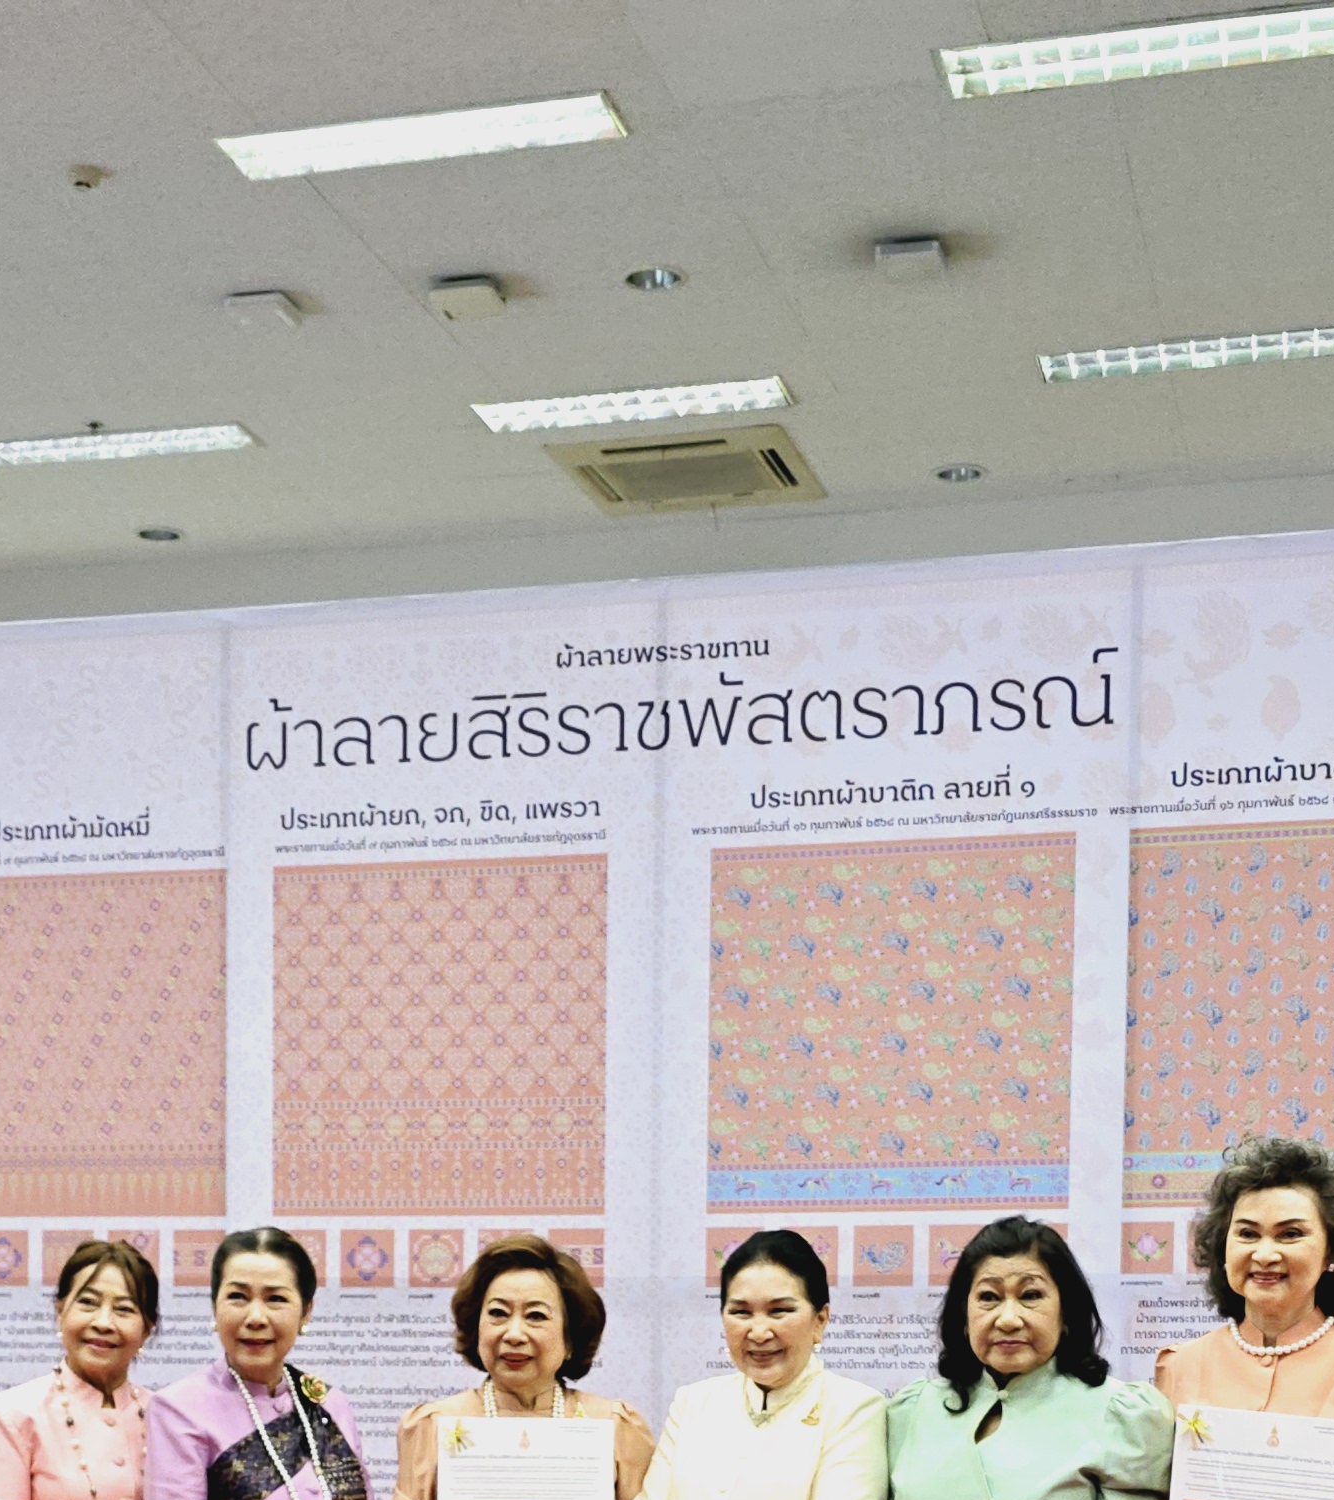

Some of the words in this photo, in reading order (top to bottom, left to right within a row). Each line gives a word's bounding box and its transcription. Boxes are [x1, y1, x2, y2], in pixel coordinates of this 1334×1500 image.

[556, 637, 770, 669] ผ้าลายพระราชทาน
[246, 647, 1119, 771] ผ้าลายสิริราชพัสตราภรณ์
[750, 779, 935, 809] ประเภทผ้าบาติก
[944, 766, 1011, 799] ลายที่
[280, 803, 426, 830] ประเภทผ้ายก,
[434, 806, 471, 827] จก,
[526, 800, 601, 820] แพรวา
[1109, 796, 1216, 815] พระราชทานเมื่อวันที่
[1238, 794, 1295, 812] กุมภาพันธ์
[691, 817, 789, 835] พระราชทานเมื่อวันที่
[811, 816, 863, 832] กุมภาพันธ์
